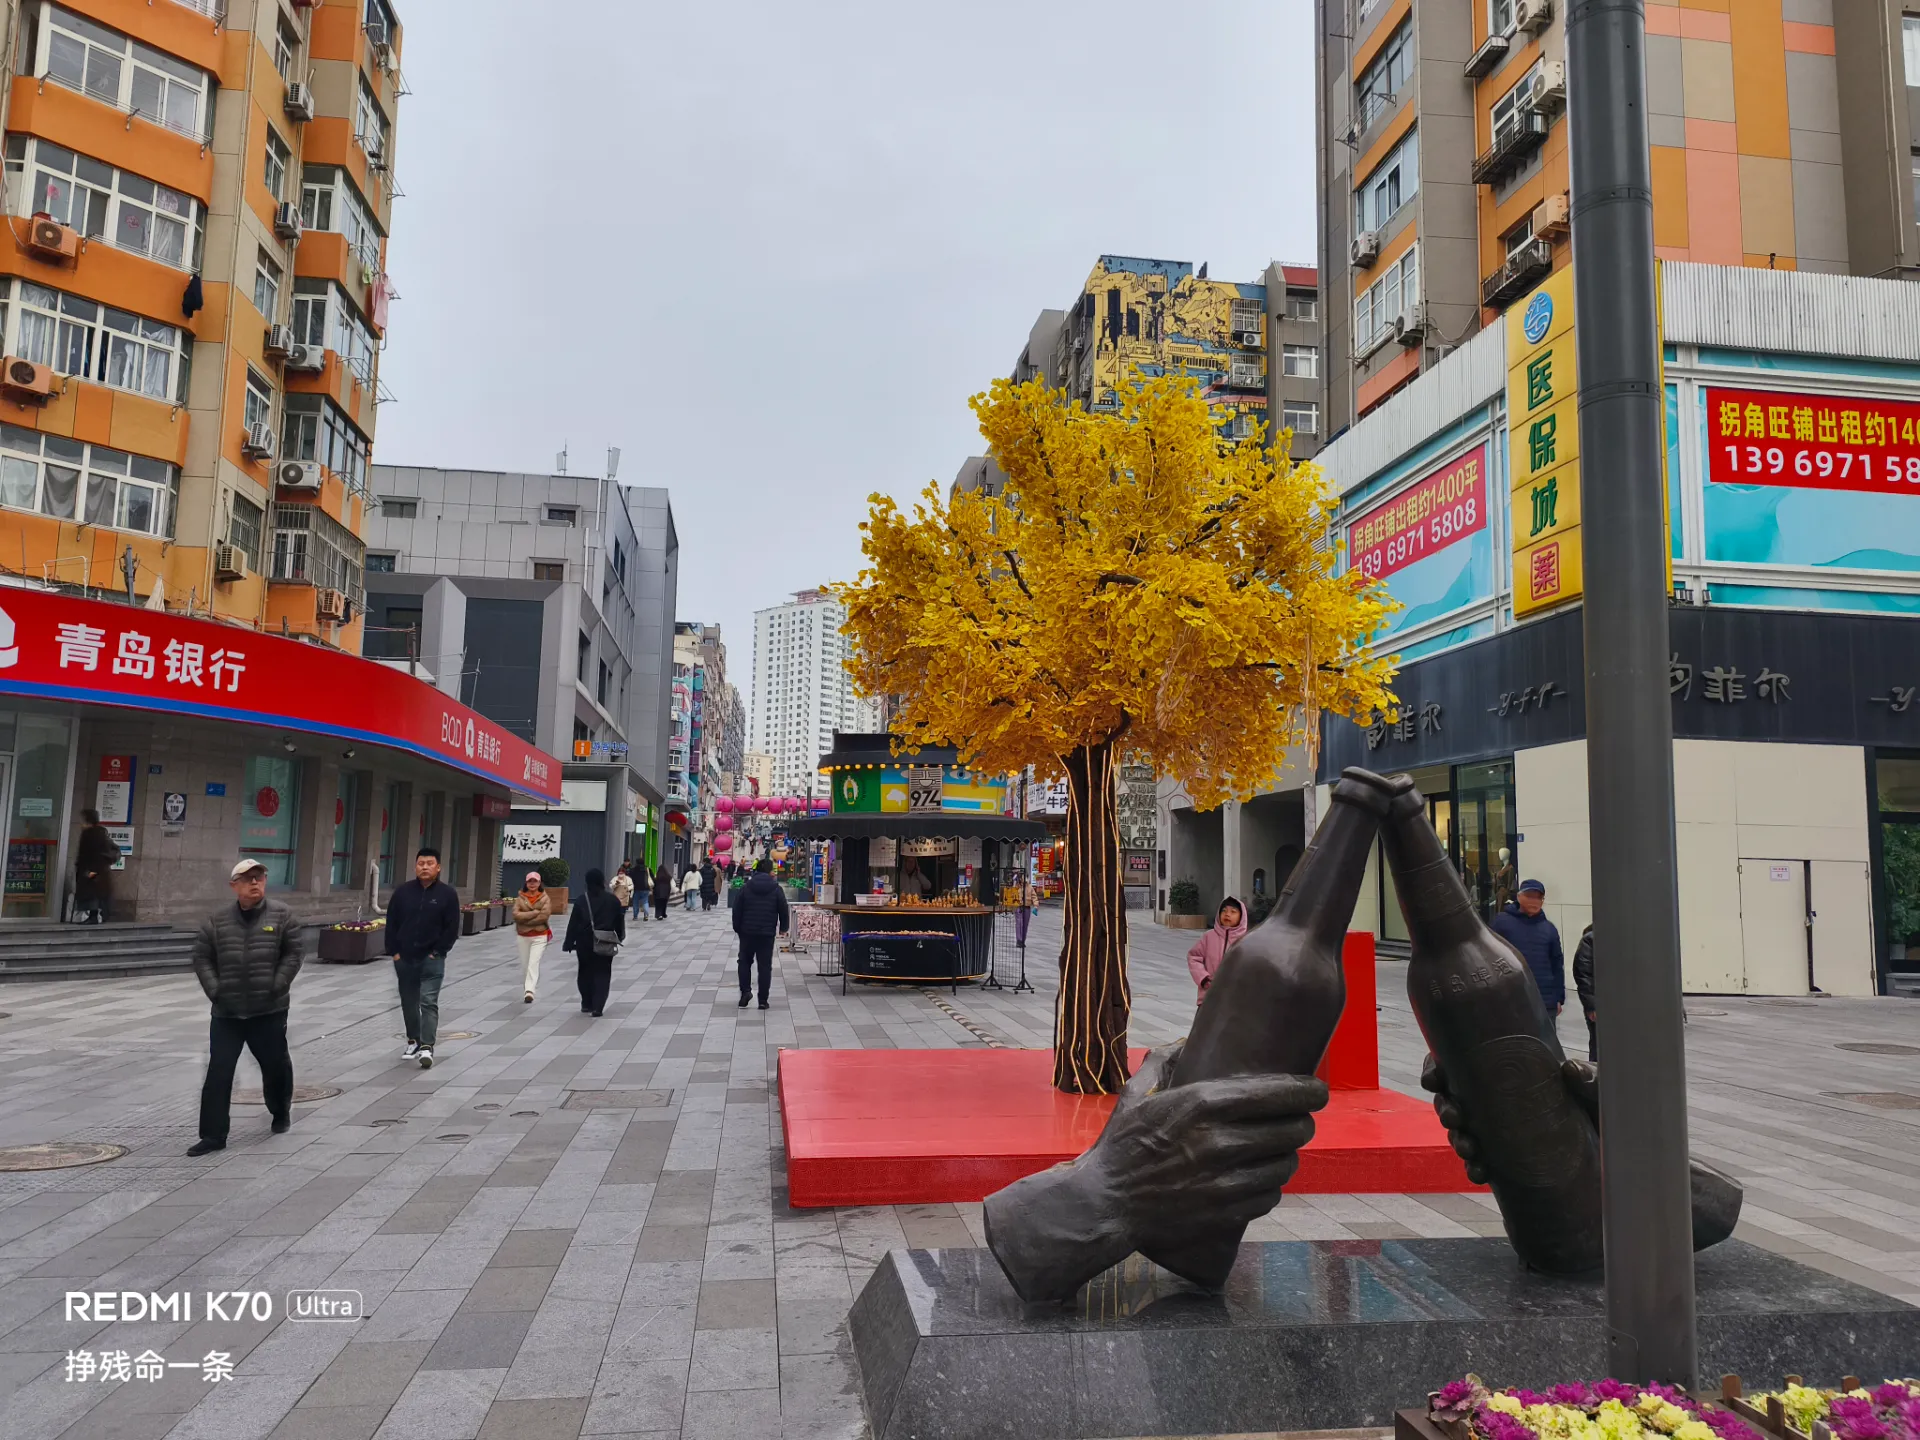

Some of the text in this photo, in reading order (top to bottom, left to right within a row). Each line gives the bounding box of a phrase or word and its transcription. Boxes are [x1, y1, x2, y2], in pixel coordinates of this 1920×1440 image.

[1526, 349, 1558, 538] 医保城
[1725, 445, 1785, 475] 139
[1794, 450, 1872, 480] 6971
[1354, 459, 1479, 556] 拐角旺铺出租约1400平
[1358, 498, 1477, 577] 139 6971 5808
[55, 622, 246, 692] 青岛银行
[441, 711, 462, 748] BQD
[477, 730, 501, 766] 青岛银行
[910, 790, 941, 807] 974
